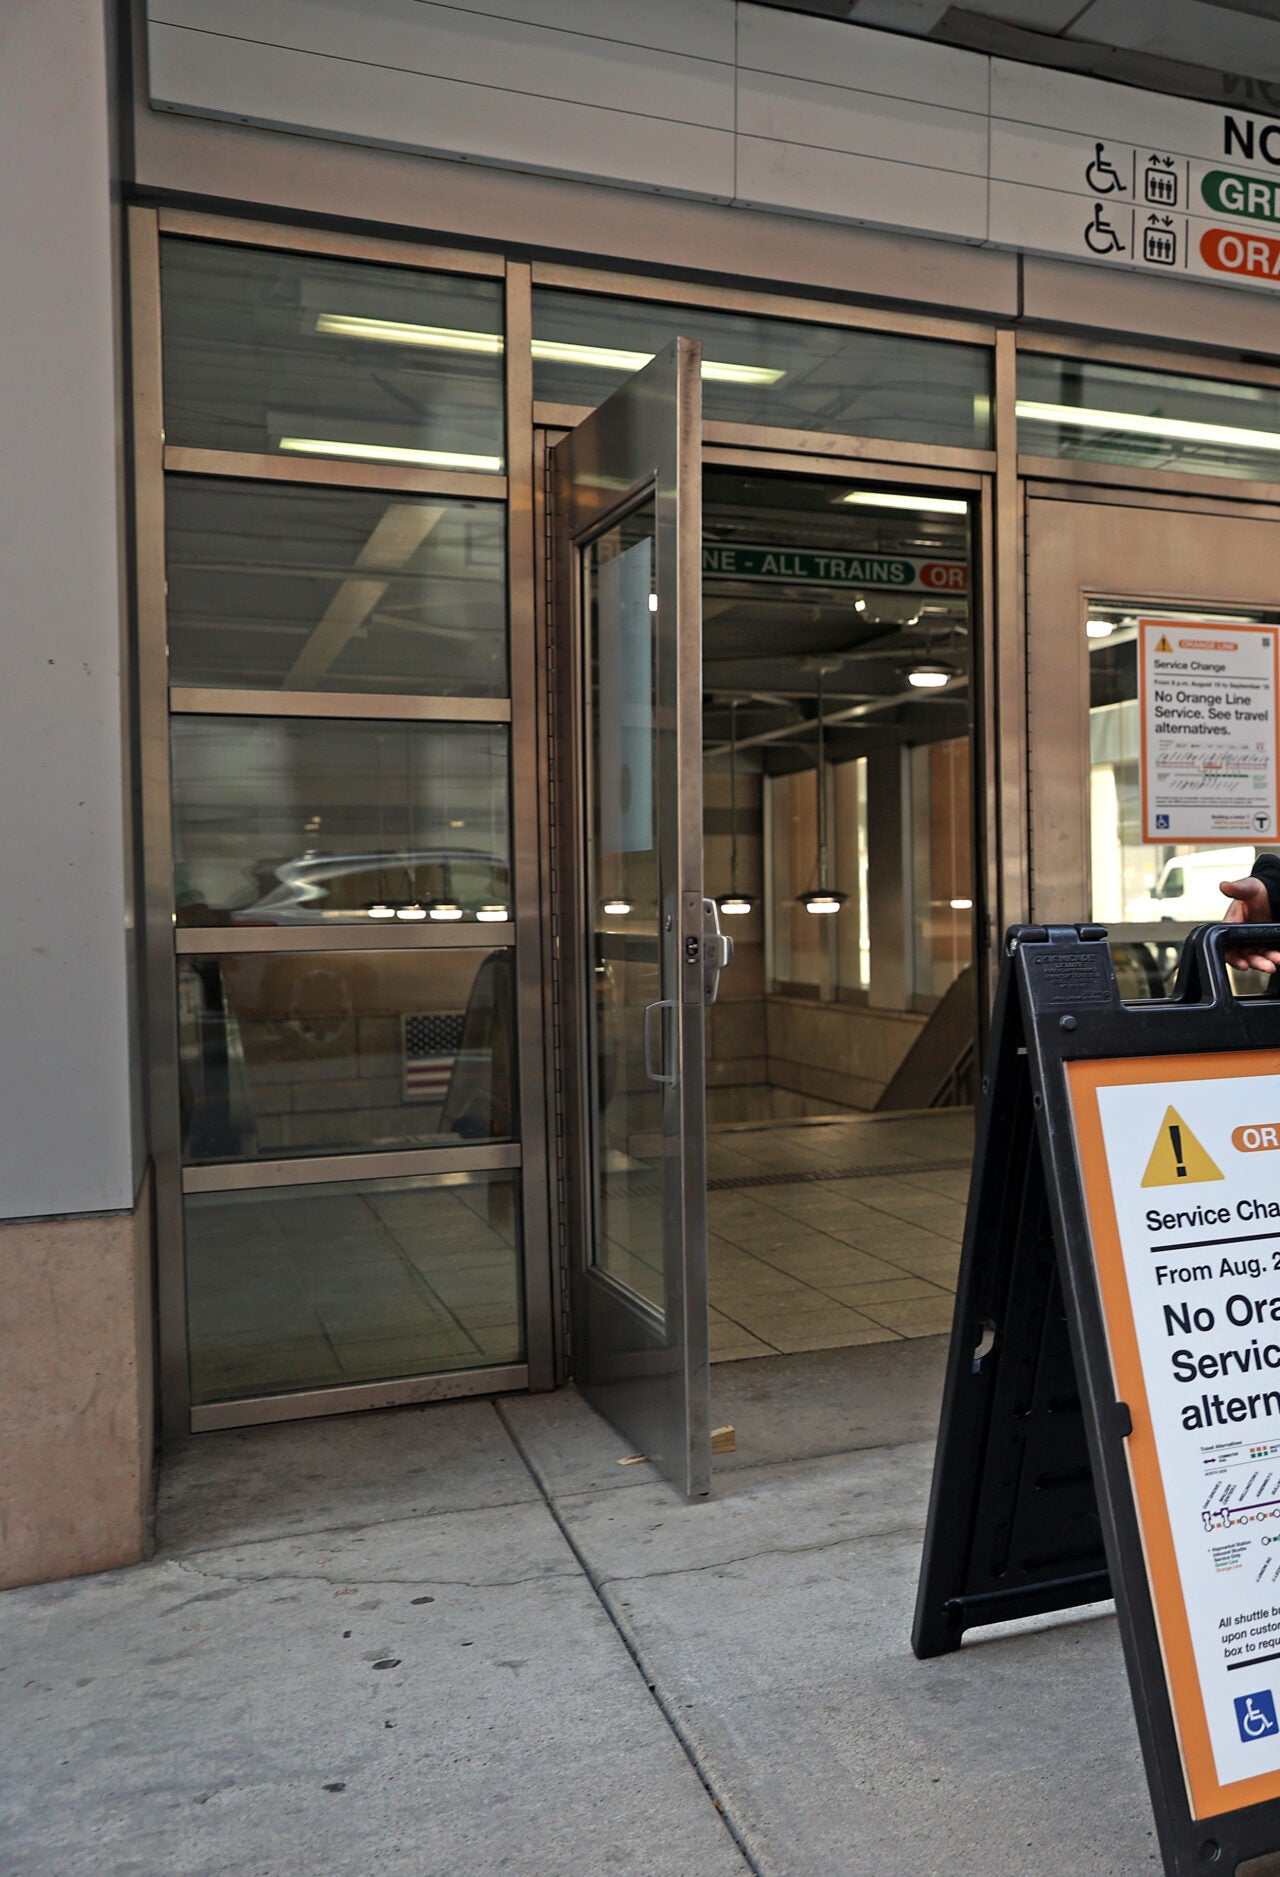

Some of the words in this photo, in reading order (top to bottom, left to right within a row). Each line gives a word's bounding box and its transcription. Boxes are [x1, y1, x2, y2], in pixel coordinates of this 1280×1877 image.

[702, 551, 736, 570] NE
[761, 554, 807, 576] ALL
[815, 557, 905, 583] TRAINS
[1154, 660, 1188, 669] Service
[1191, 661, 1225, 672] Change
[1155, 691, 1173, 702] No
[1176, 691, 1222, 706] Orange
[1226, 694, 1251, 705] Line
[1155, 706, 1204, 719] Service.
[1208, 708, 1231, 720] See
[1235, 710, 1268, 721] travel
[1155, 723, 1230, 735] alternatives.
[1146, 1205, 1230, 1231] Service
[1155, 1265, 1212, 1285] From
[1219, 1258, 1266, 1278] Aug.
[1163, 1302, 1214, 1336] No
[1218, 1616, 1231, 1628] All
[1234, 1609, 1269, 1625] shuttle
[1221, 1630, 1247, 1643] upon
[1224, 1646, 1242, 1657] box
[1245, 1643, 1255, 1652] to
